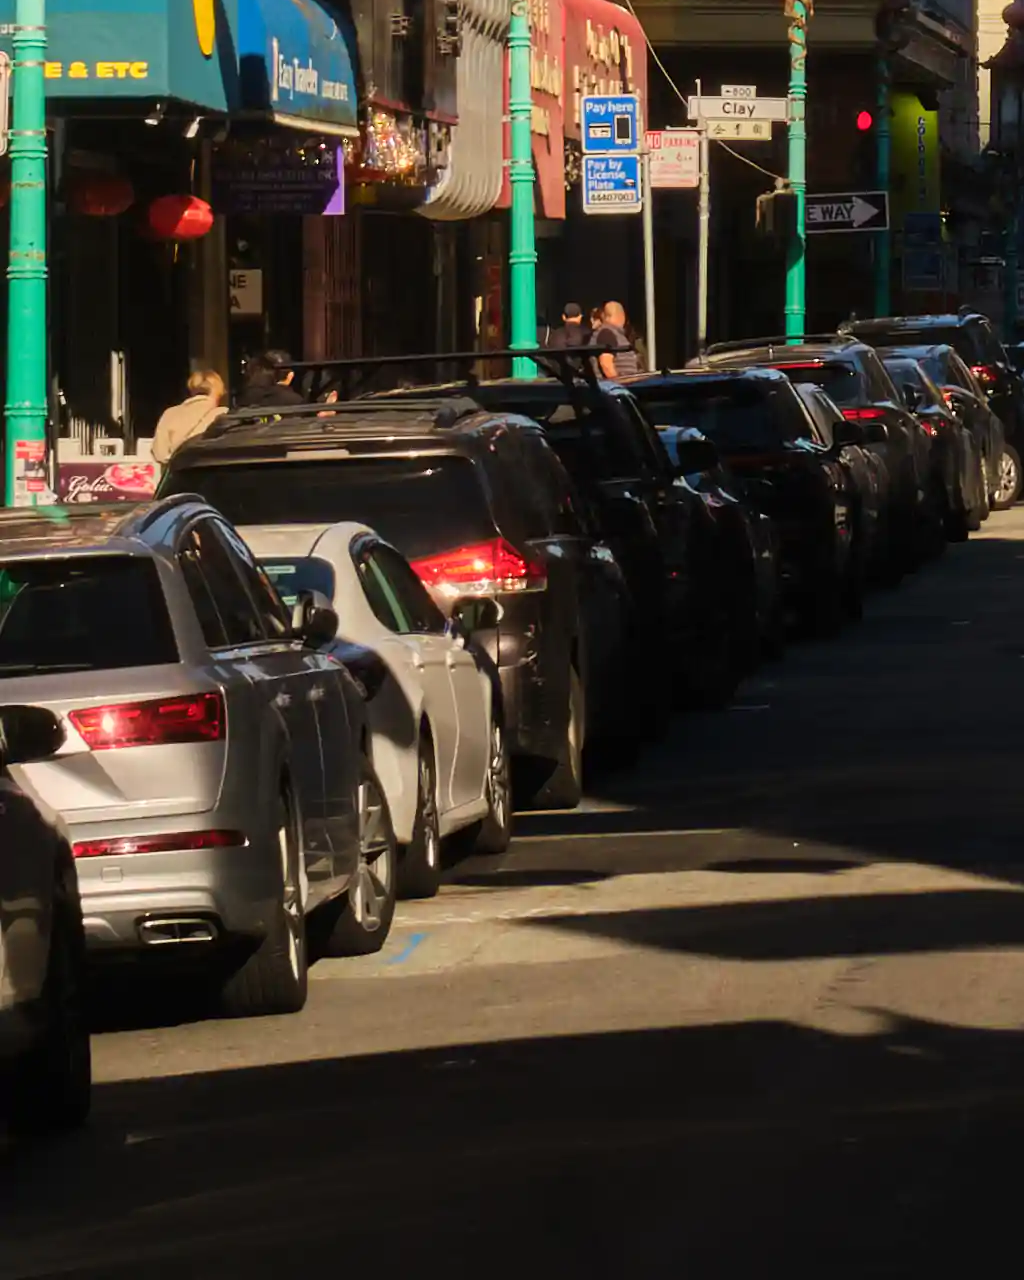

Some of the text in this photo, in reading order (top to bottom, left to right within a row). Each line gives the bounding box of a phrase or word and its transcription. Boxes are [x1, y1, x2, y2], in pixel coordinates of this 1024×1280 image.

[68, 61, 88, 79] &
[96, 61, 149, 79] ETC
[586, 101, 634, 116] Pay here
[722, 101, 756, 117] Clay
[645, 133, 661, 149] NO
[587, 158, 623, 171] Pay by
[587, 169, 627, 180] License
[587, 179, 615, 190] Plate
[820, 203, 856, 221] WAY
